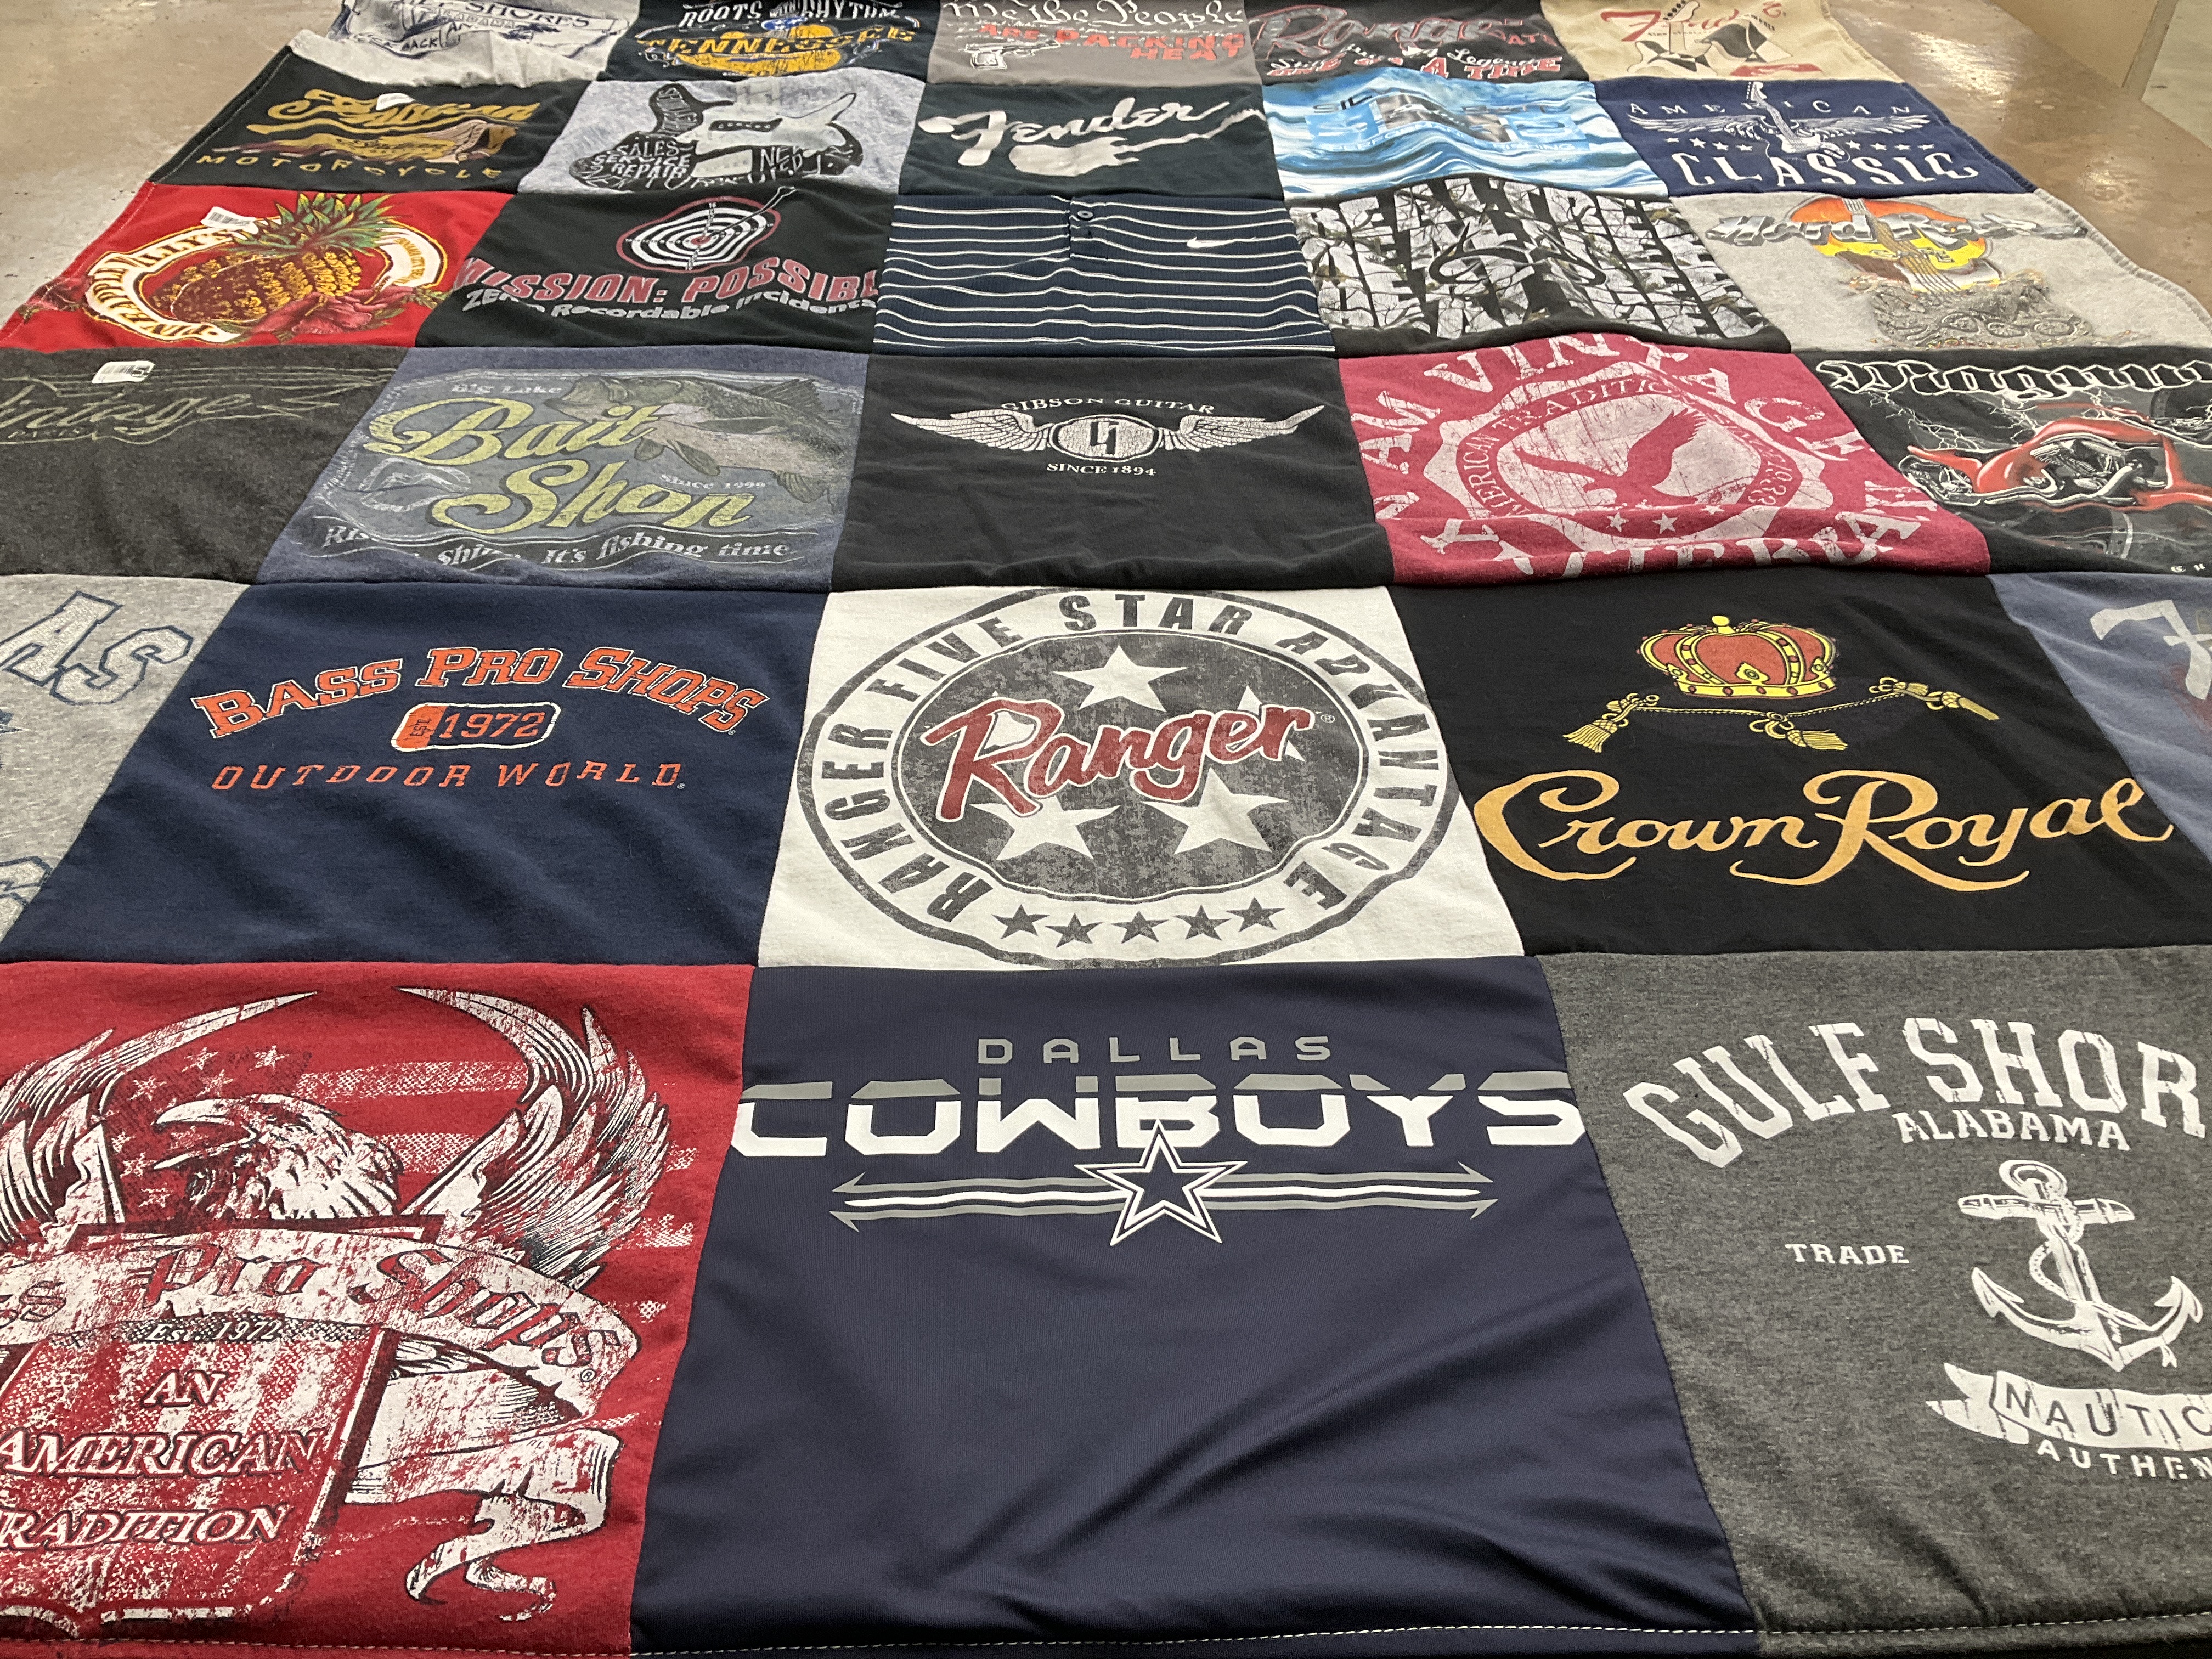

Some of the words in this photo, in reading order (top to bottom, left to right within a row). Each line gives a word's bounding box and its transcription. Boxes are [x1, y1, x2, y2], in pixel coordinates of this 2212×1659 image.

[679, 0, 762, 28] ROOTS
[1629, 100, 1912, 116] AMERICAN
[918, 97, 1231, 166] Fender
[196, 154, 503, 179] MOTORCYCLE
[1672, 152, 1979, 187] CLASSIC
[551, 302, 730, 320] Recordable
[1001, 398, 1104, 411] GIBSON
[1114, 398, 1216, 415] GUITAR
[363, 397, 662, 466] Bait
[1047, 462, 1107, 475] SINCE
[1112, 465, 1157, 476] 1894
[541, 548, 587, 565] It's
[596, 531, 708, 561] fishing
[718, 541, 791, 557] time
[1058, 593, 1254, 636] STAR
[865, 614, 1023, 703] FIVE
[190, 658, 403, 739] BASS
[414, 647, 563, 687] PRO
[562, 646, 769, 732] SHOPS
[439, 712, 546, 738] 1972
[212, 764, 467, 790] OUTDOOR
[497, 760, 681, 788] WORLD
[922, 695, 1319, 822] Ranger
[1279, 630, 1443, 912] ADVANTAGE
[821, 724, 994, 925] RANGER
[1472, 769, 1820, 882] Crown
[1729, 769, 2176, 892] Royal
[978, 1036, 1331, 1065] DALLAS
[730, 1071, 1587, 1156] COWBOYS
[1622, 1022, 1891, 1169] GULF
[1891, 1108, 2131, 1151] ALABAMA
[1785, 1243, 1910, 1265] TRADE
[216, 1320, 284, 1342] 1972
[139, 1369, 227, 1407] AN
[0, 1427, 329, 1480] AMERICAN
